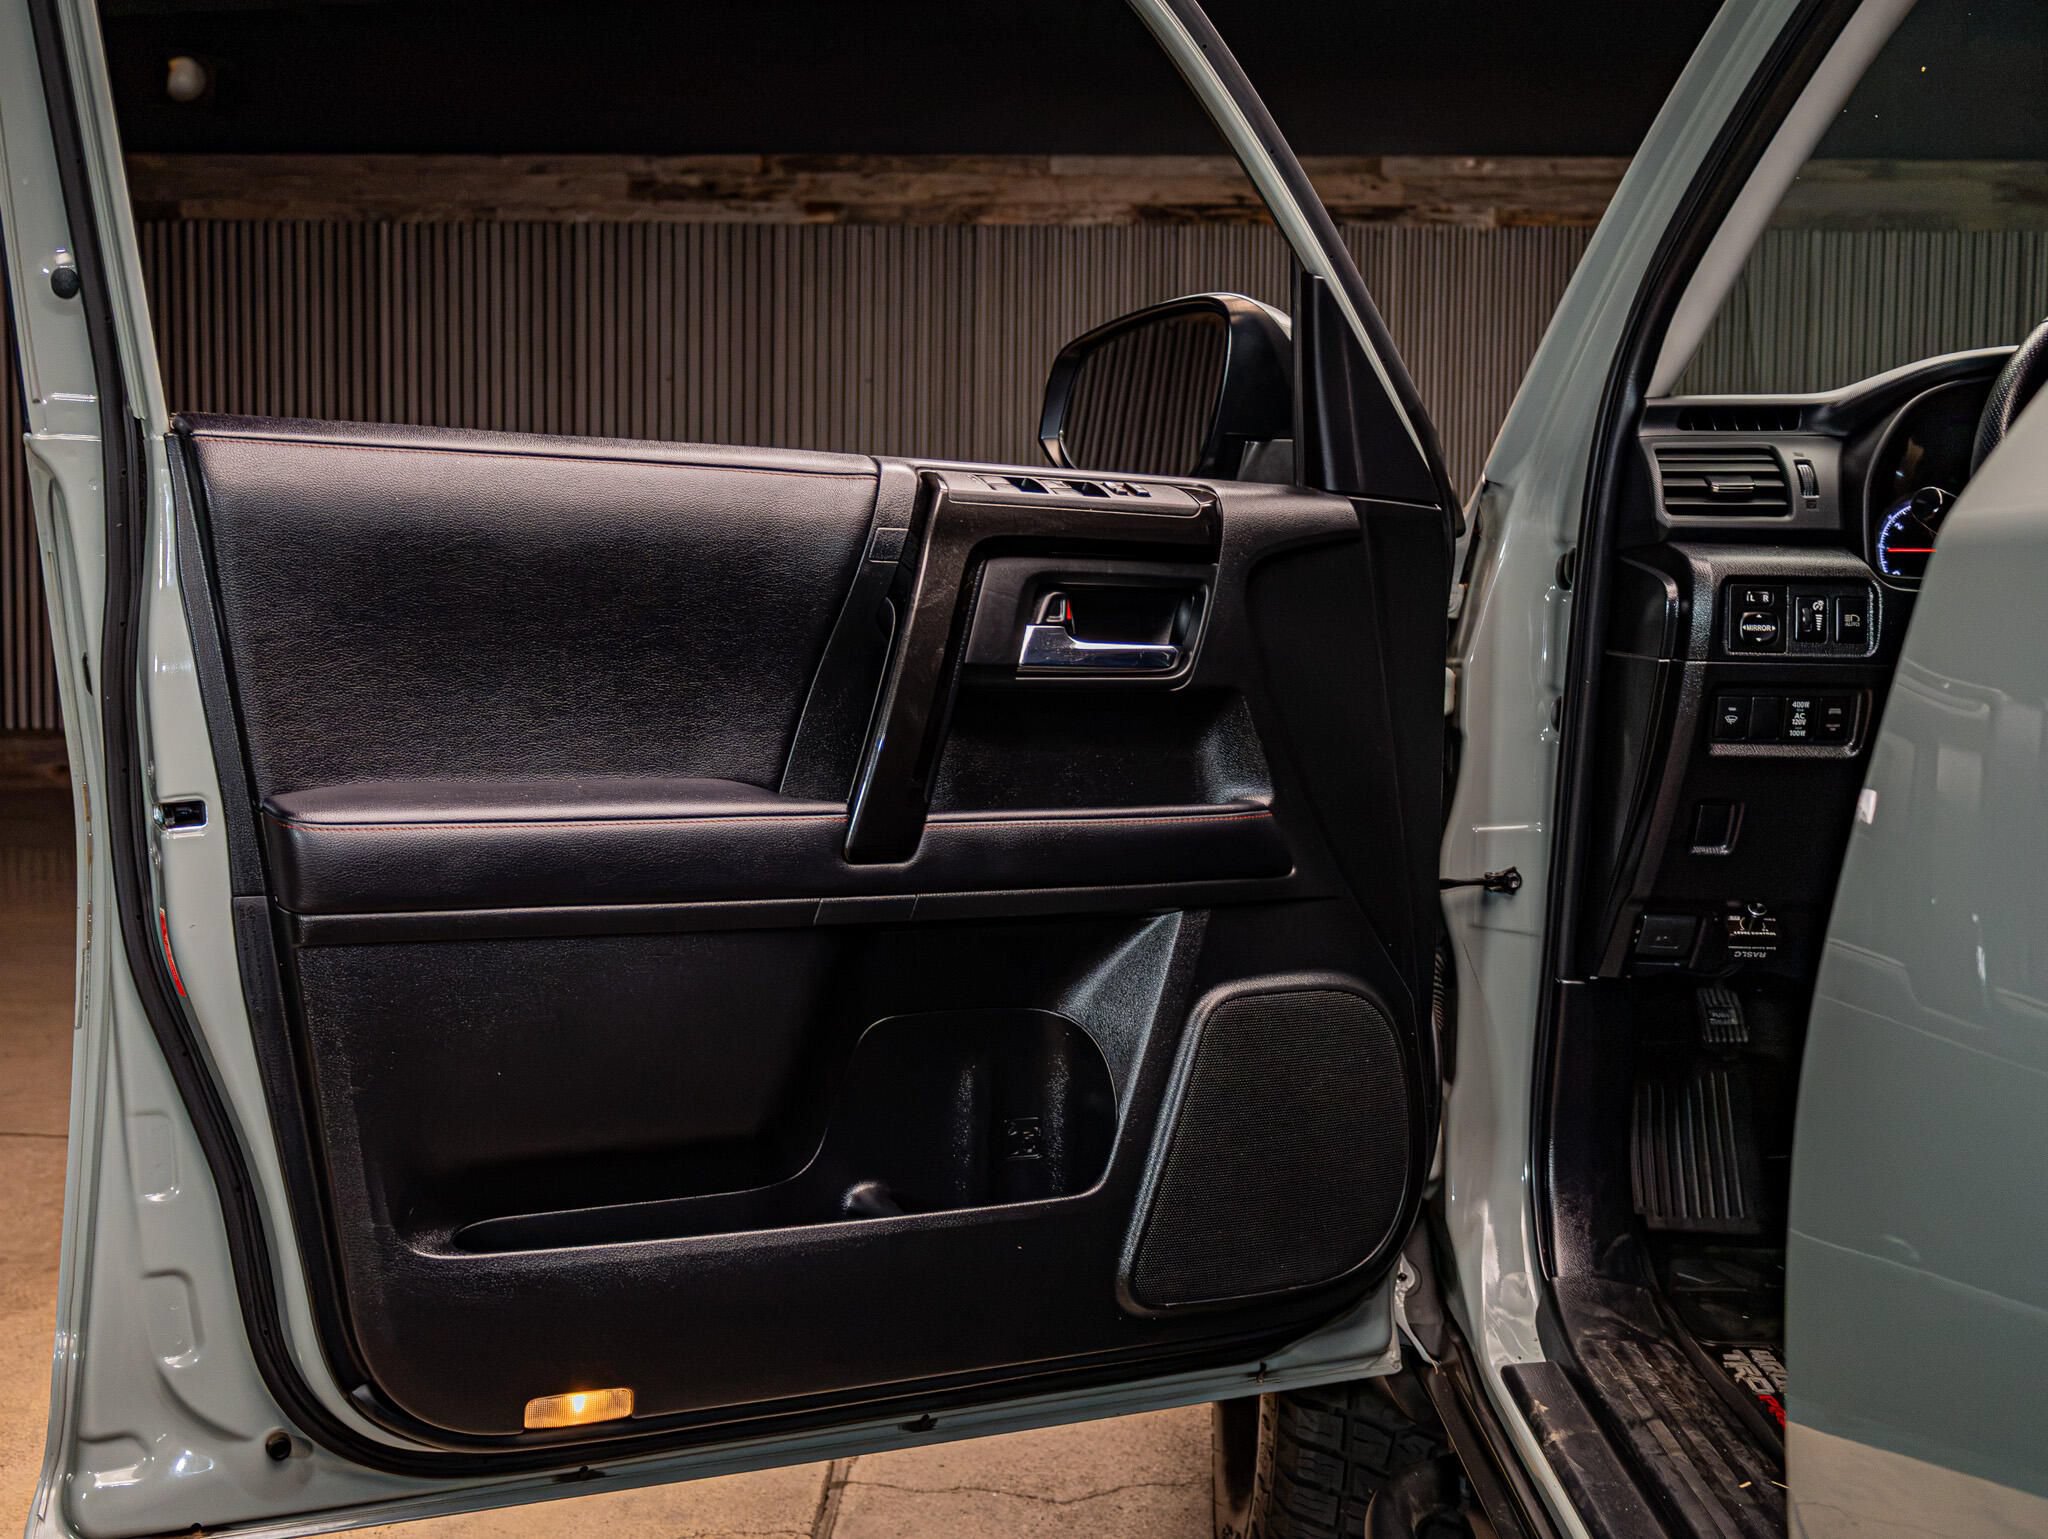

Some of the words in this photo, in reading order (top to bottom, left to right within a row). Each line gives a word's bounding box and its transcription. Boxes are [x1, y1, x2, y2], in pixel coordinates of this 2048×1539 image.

[1746, 624, 1772, 632] MIRROR
[1791, 700, 1811, 709] 400W
[1794, 712, 1806, 720] AC
[1791, 718, 1807, 726] 120V
[1788, 729, 1807, 737] 100W
[1733, 950, 1767, 959] RASLC
